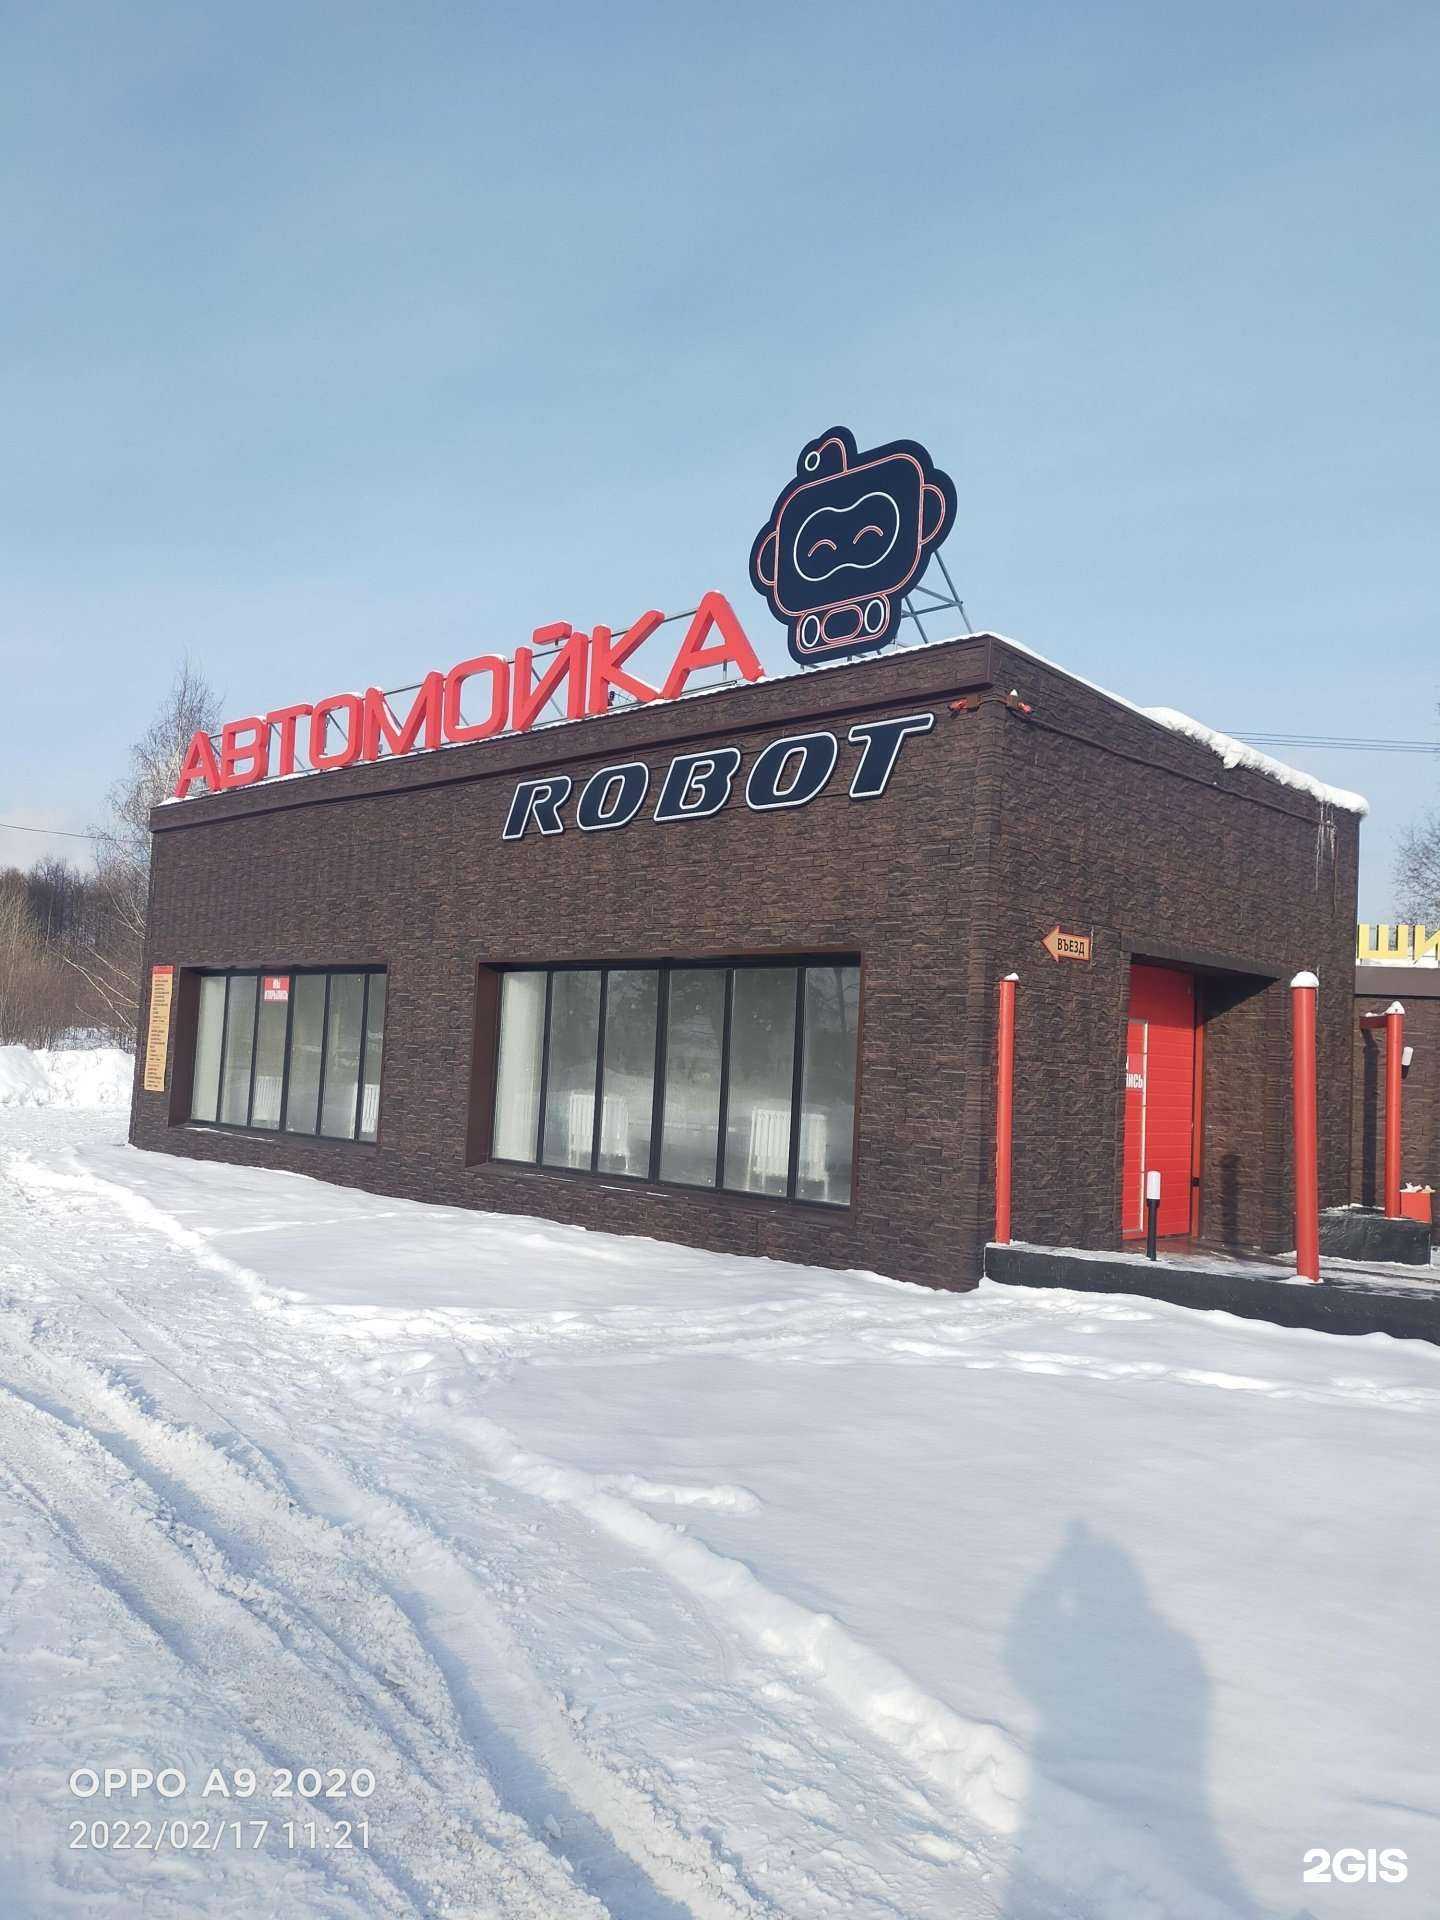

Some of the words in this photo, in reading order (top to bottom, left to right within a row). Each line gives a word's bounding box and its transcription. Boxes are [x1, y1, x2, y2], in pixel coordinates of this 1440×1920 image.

[174, 590, 767, 798] АВТОМОЙКА
[502, 711, 936, 841] ROBOT
[1057, 937, 1085, 957] ВЪЕЗД
